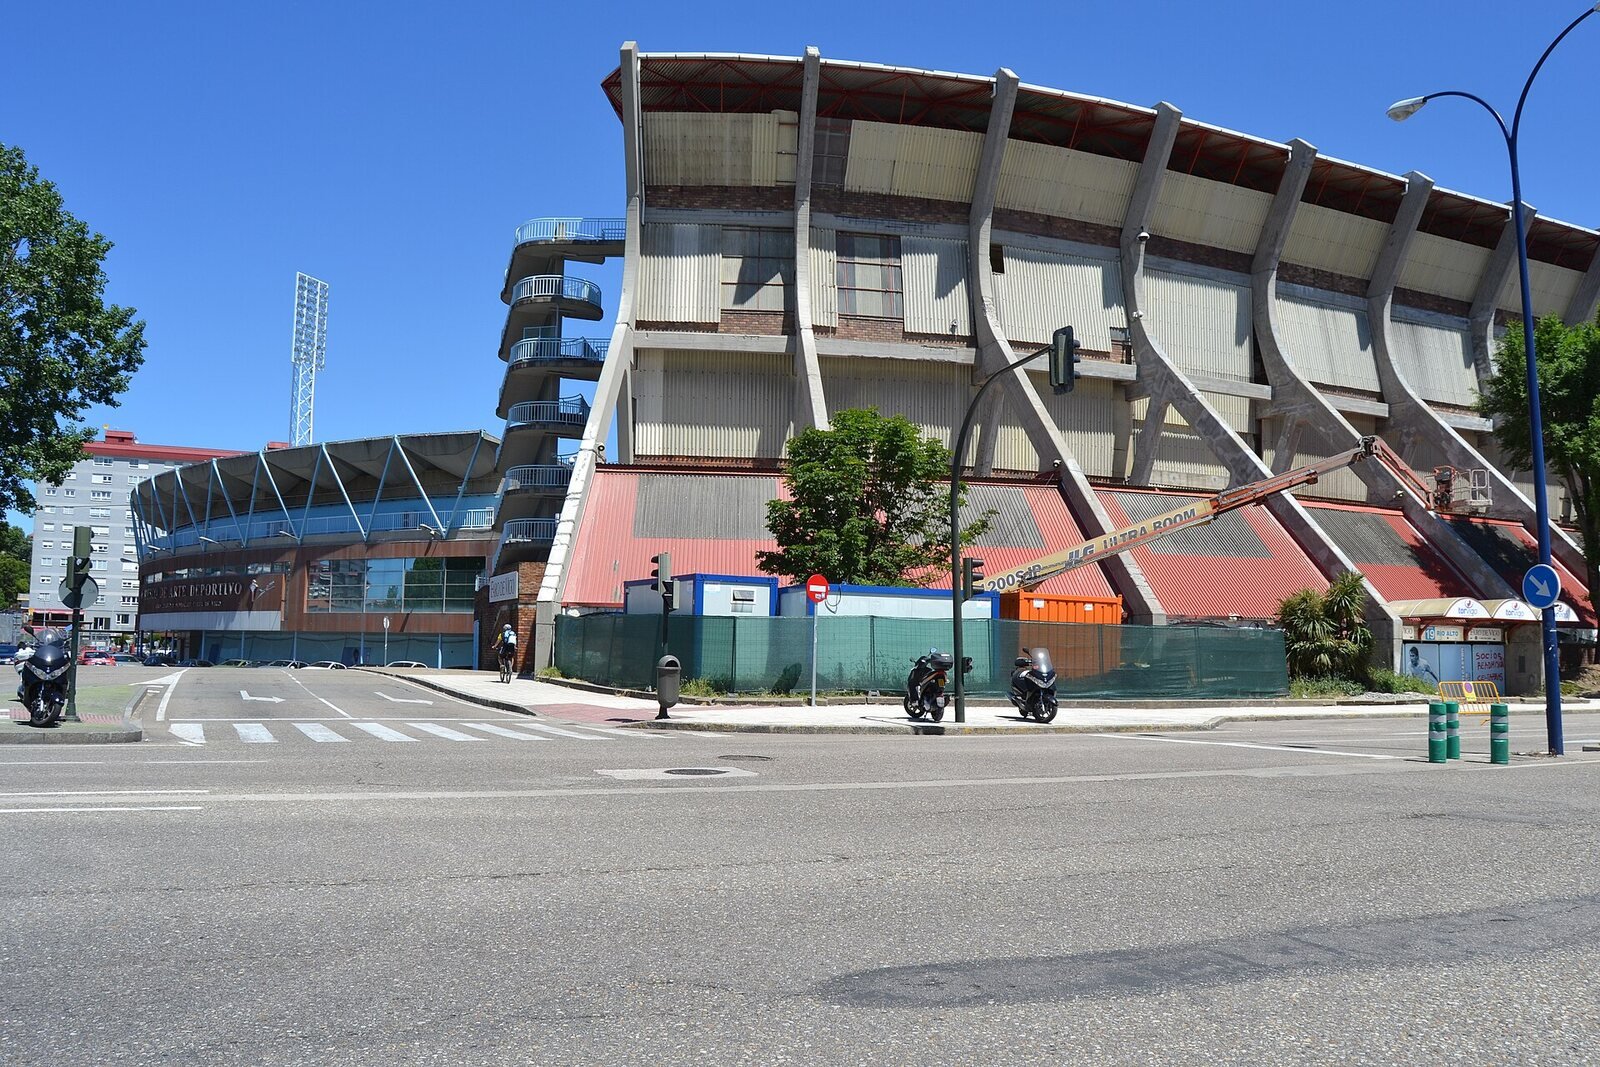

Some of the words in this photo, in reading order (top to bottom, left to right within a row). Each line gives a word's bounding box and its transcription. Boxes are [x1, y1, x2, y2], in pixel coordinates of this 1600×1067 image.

[1153, 508, 1196, 531] BOOM
[169, 585, 187, 598] ARTE
[190, 582, 242, 597] DEPORTIVO
[1426, 629, 1435, 640] 19
